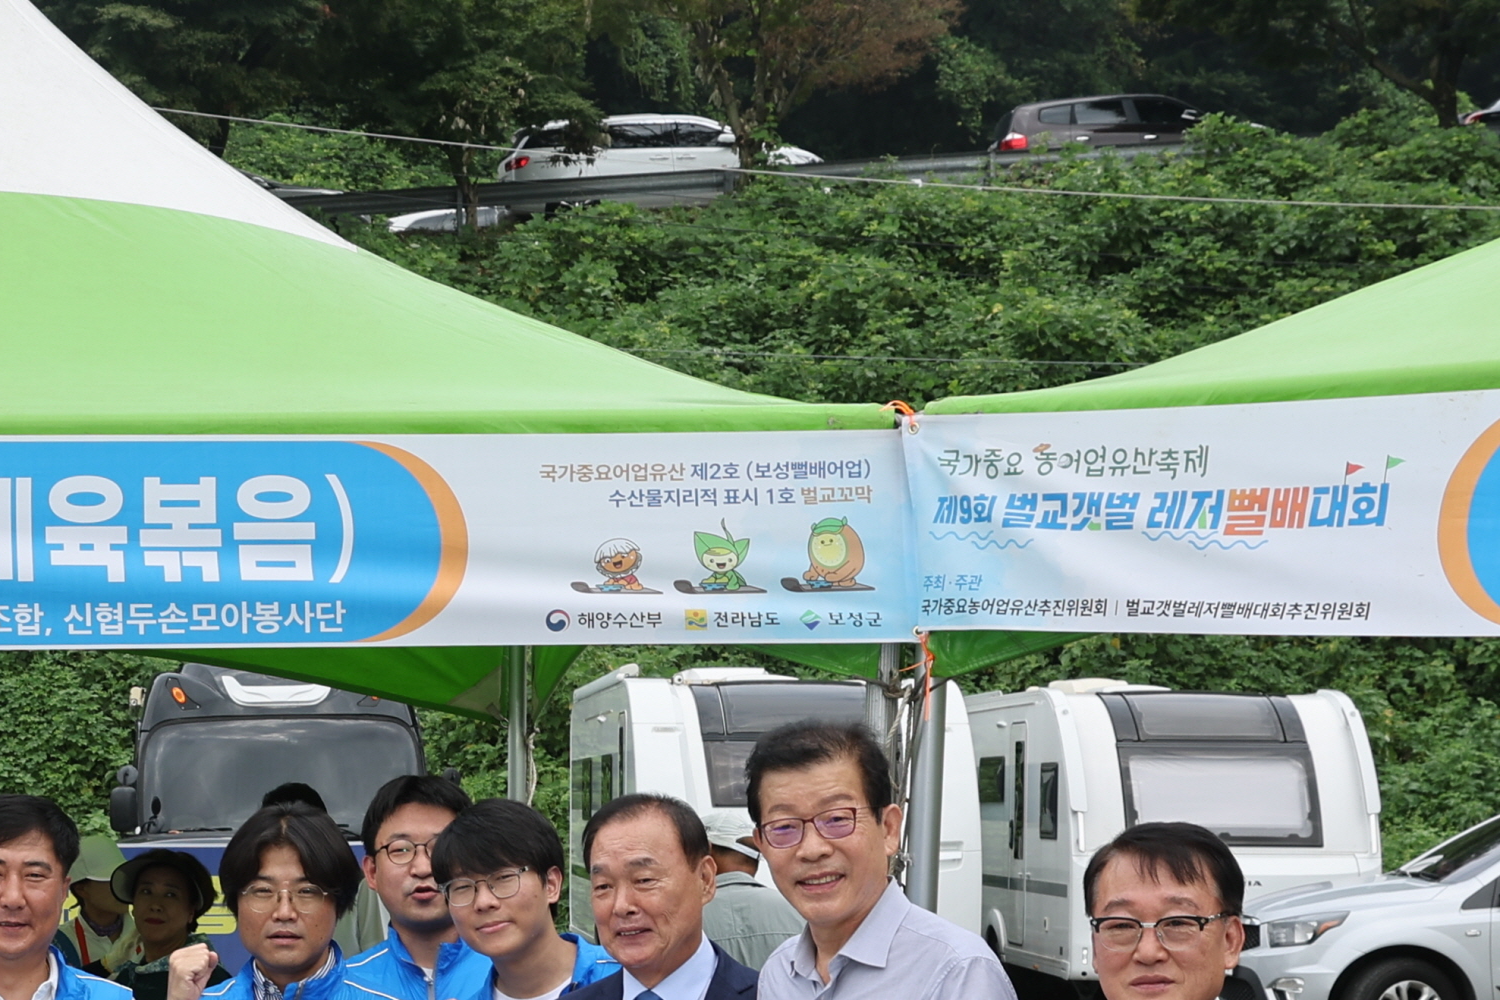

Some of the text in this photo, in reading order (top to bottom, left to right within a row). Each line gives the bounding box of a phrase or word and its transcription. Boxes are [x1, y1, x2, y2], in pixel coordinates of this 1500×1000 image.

[539, 459, 872, 483] 국가중요어업유산 제2호 (보성뻘배어업)
[937, 448, 1024, 480] 국가중요
[608, 485, 873, 508] 수산물지리적 표시 1호 벌교꼬막
[933, 482, 1390, 536] 제9회 벌교갯벌 레저뻘배대회
[63, 601, 346, 636] 신협두손모아봉사단
[577, 611, 883, 629] 해양수산부 전라남도 보성군
[921, 598, 1371, 621] 국가중요농어업유산추진위원회 벌교갯벌레저뻘배대회추진위원회
